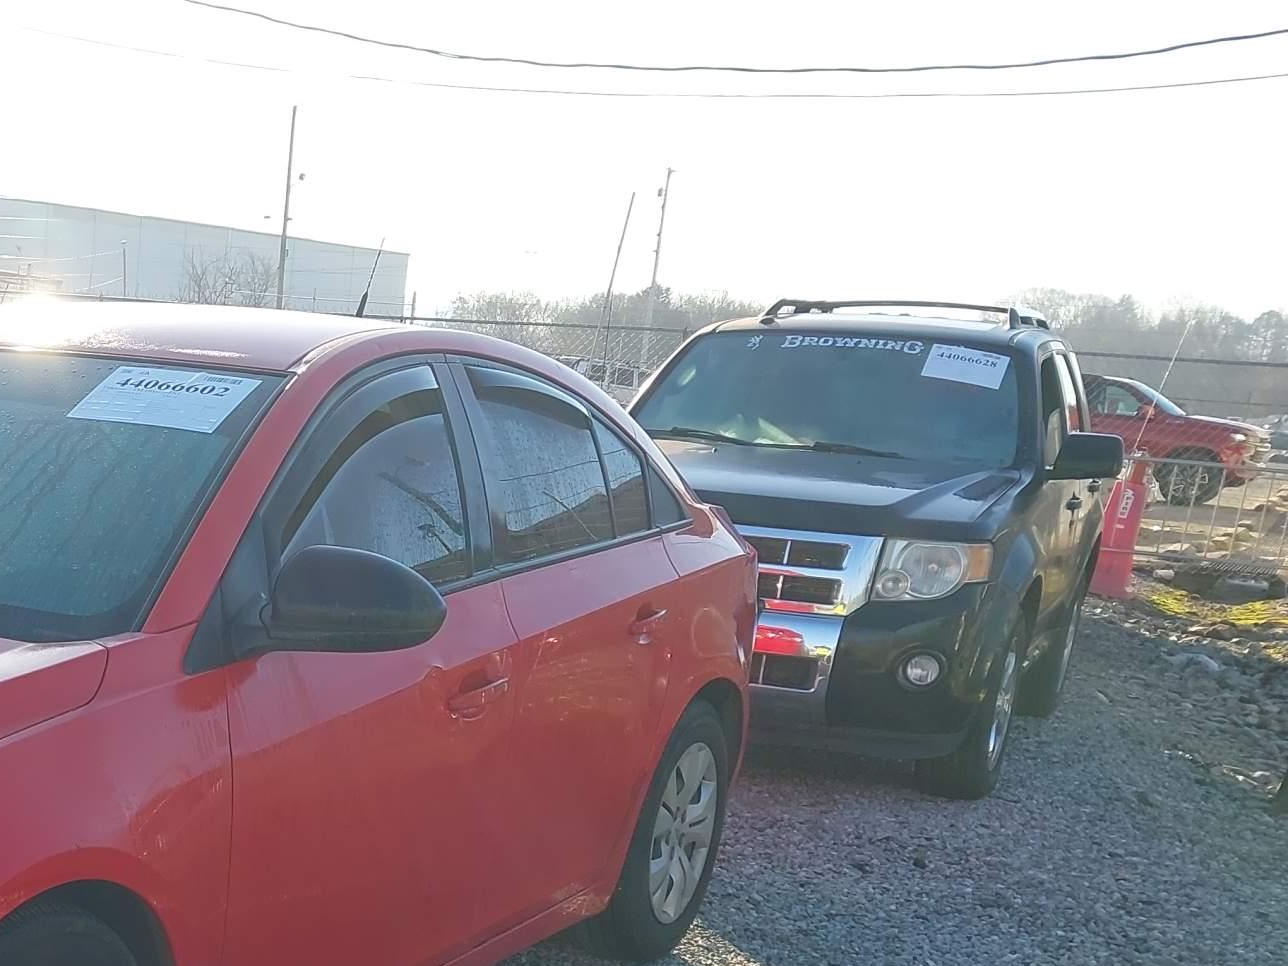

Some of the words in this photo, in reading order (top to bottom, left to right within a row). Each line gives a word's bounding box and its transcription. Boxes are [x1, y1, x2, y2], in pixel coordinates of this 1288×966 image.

[780, 334, 924, 355] BROWNING
[936, 351, 999, 369] 44066628
[116, 377, 231, 398] 44066602
